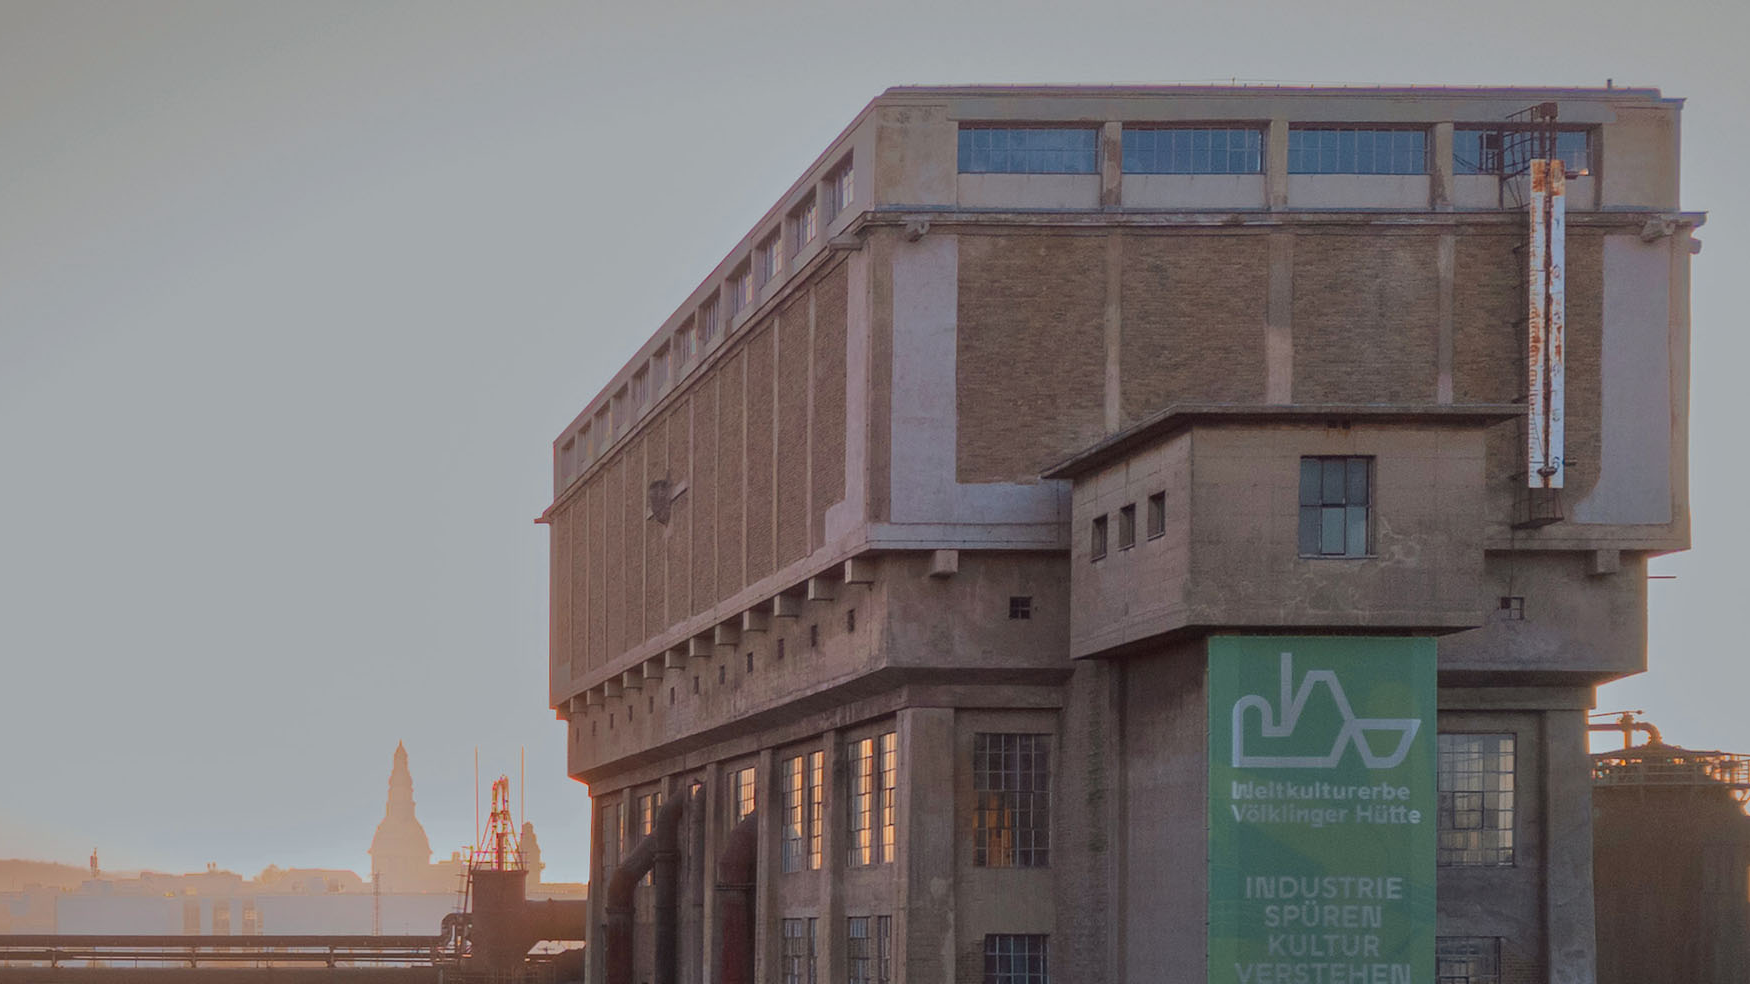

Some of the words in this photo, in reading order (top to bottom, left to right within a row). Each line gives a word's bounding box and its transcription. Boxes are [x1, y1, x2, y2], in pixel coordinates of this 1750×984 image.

[1231, 781, 1410, 800] Weltkulturerbe
[1231, 804, 1348, 828] Völklinger
[1356, 805, 1421, 824] Hütte
[1246, 876, 1402, 899] INDUSTRIE
[1264, 901, 1382, 928] SPÜREN
[1268, 934, 1380, 957] KULTUR
